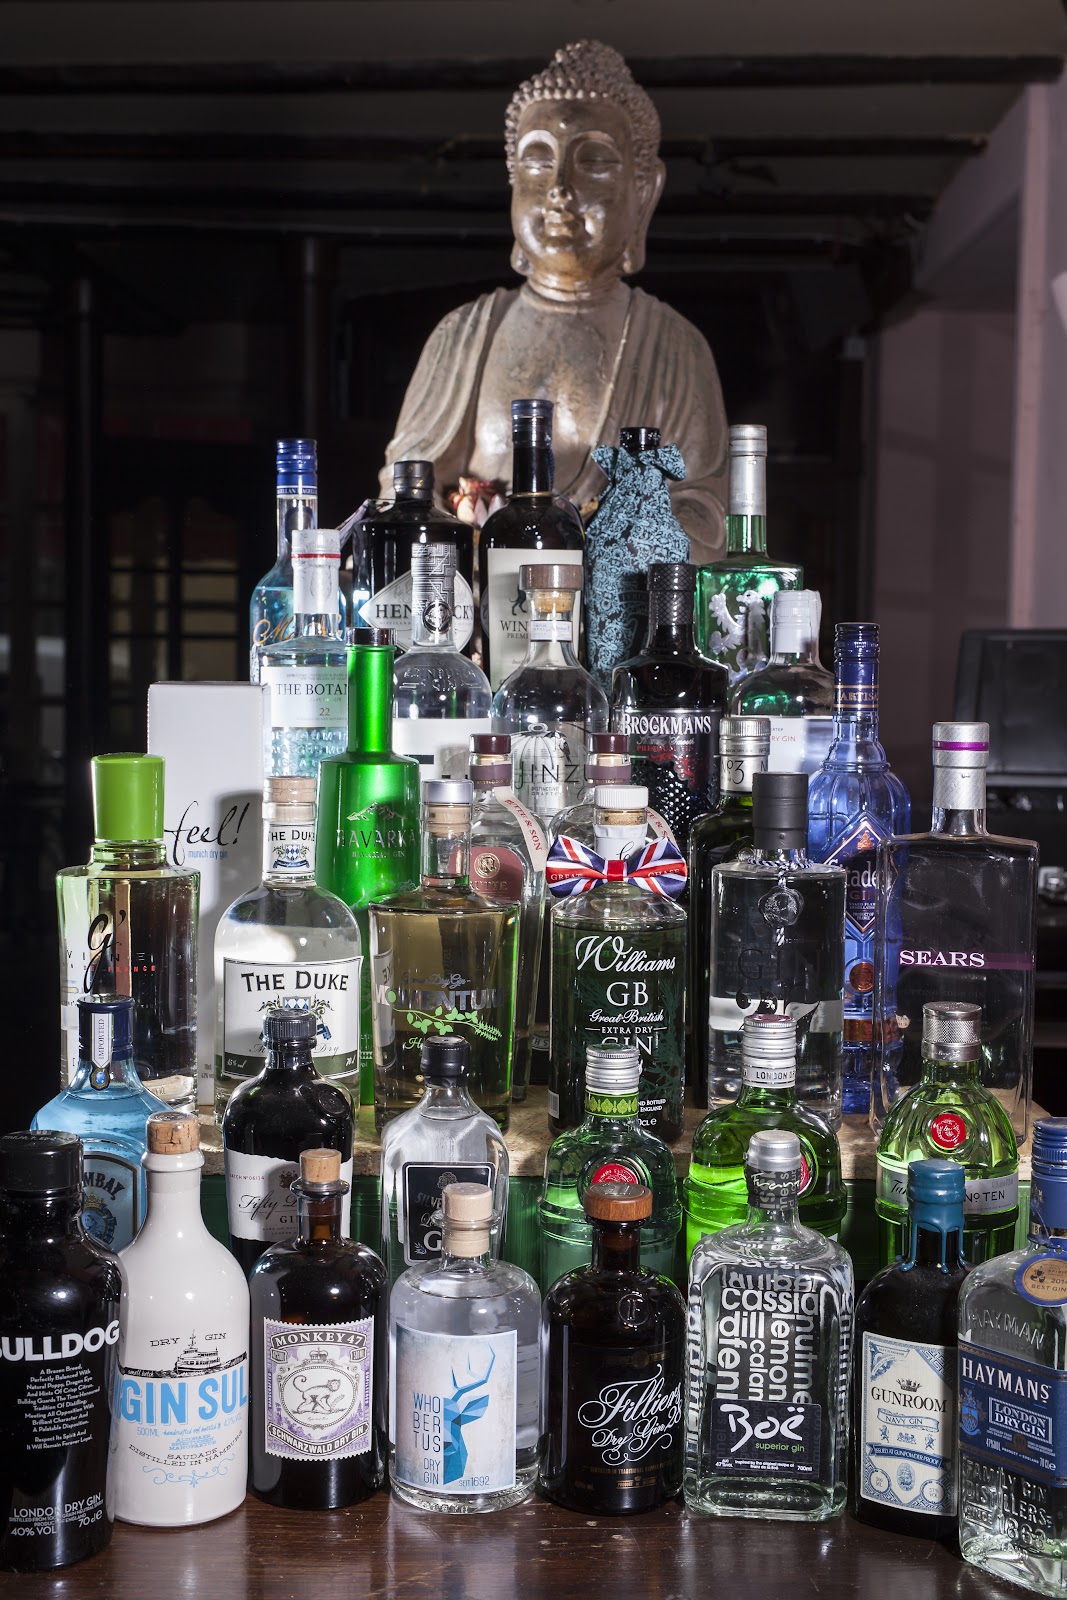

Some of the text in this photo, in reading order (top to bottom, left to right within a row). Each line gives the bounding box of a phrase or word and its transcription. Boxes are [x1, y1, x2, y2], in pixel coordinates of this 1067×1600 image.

[276, 684, 346, 696] THE BOTA
[320, 708, 330, 716] 22
[620, 713, 712, 736] BROCKMANS
[164, 800, 250, 866] feel!
[530, 829, 542, 851] SON
[188, 850, 228, 860] munich dry gin
[576, 936, 676, 972] Williams
[900, 950, 986, 968] SEARS
[241, 970, 349, 992] THE DUKE
[431, 974, 450, 988] Dry
[606, 982, 649, 1006] GB
[588, 1008, 664, 1023] Great British
[756, 1072, 788, 1080] LONDON
[84, 1172, 125, 1200] MBAY
[982, 1190, 1004, 1201] TEN
[238, 1190, 278, 1220] Fifty
[722, 1288, 819, 1316] cassia
[719, 1311, 764, 1338] dill
[0, 1320, 120, 1362] ULLDOG
[150, 1332, 226, 1346] DRY GIN
[274, 1332, 364, 1348] MONKEY 47
[768, 1313, 798, 1400] lemon
[791, 1314, 818, 1404] nutme
[716, 1338, 748, 1400] fen
[121, 1378, 188, 1425] GIN
[198, 1366, 247, 1420] SUL
[413, 1392, 441, 1414] WHO
[577, 1364, 682, 1429] Filliers
[871, 1386, 947, 1412] GUNROOM
[56, 1408, 83, 1416] Opposition
[413, 1411, 441, 1434] BER
[886, 1416, 906, 1424] NAVY
[994, 1402, 1046, 1428] LONDON
[38, 1424, 62, 1432] Palatable
[137, 1427, 159, 1436] 500ML
[720, 1404, 805, 1453] Boë
[994, 1412, 1046, 1438] DRY GIN
[128, 1444, 186, 1466] DISTILLED
[205, 1429, 242, 1462] HAMBURG
[272, 1425, 364, 1454] SCHWARZWALD DRY GIN
[413, 1430, 441, 1452] TUS
[592, 1427, 633, 1458] Dry
[629, 1416, 666, 1452] Gin
[756, 1442, 805, 1454] superior gin
[167, 1448, 218, 1460] SAUDADE
[424, 1458, 441, 1472] DRY
[894, 1448, 923, 1461] GUNPOWDER
[924, 1456, 938, 1464] PROOF
[1002, 1448, 1040, 1464] PRODUCT ENGLAND
[424, 1472, 439, 1485] GIN
[458, 1476, 490, 1487] SEIT 1692
[65, 1499, 86, 1513] DRY
[86, 1492, 102, 1506] GIN
[1022, 1481, 1047, 1504] GIN
[10, 1526, 58, 1536] 40% VOL
